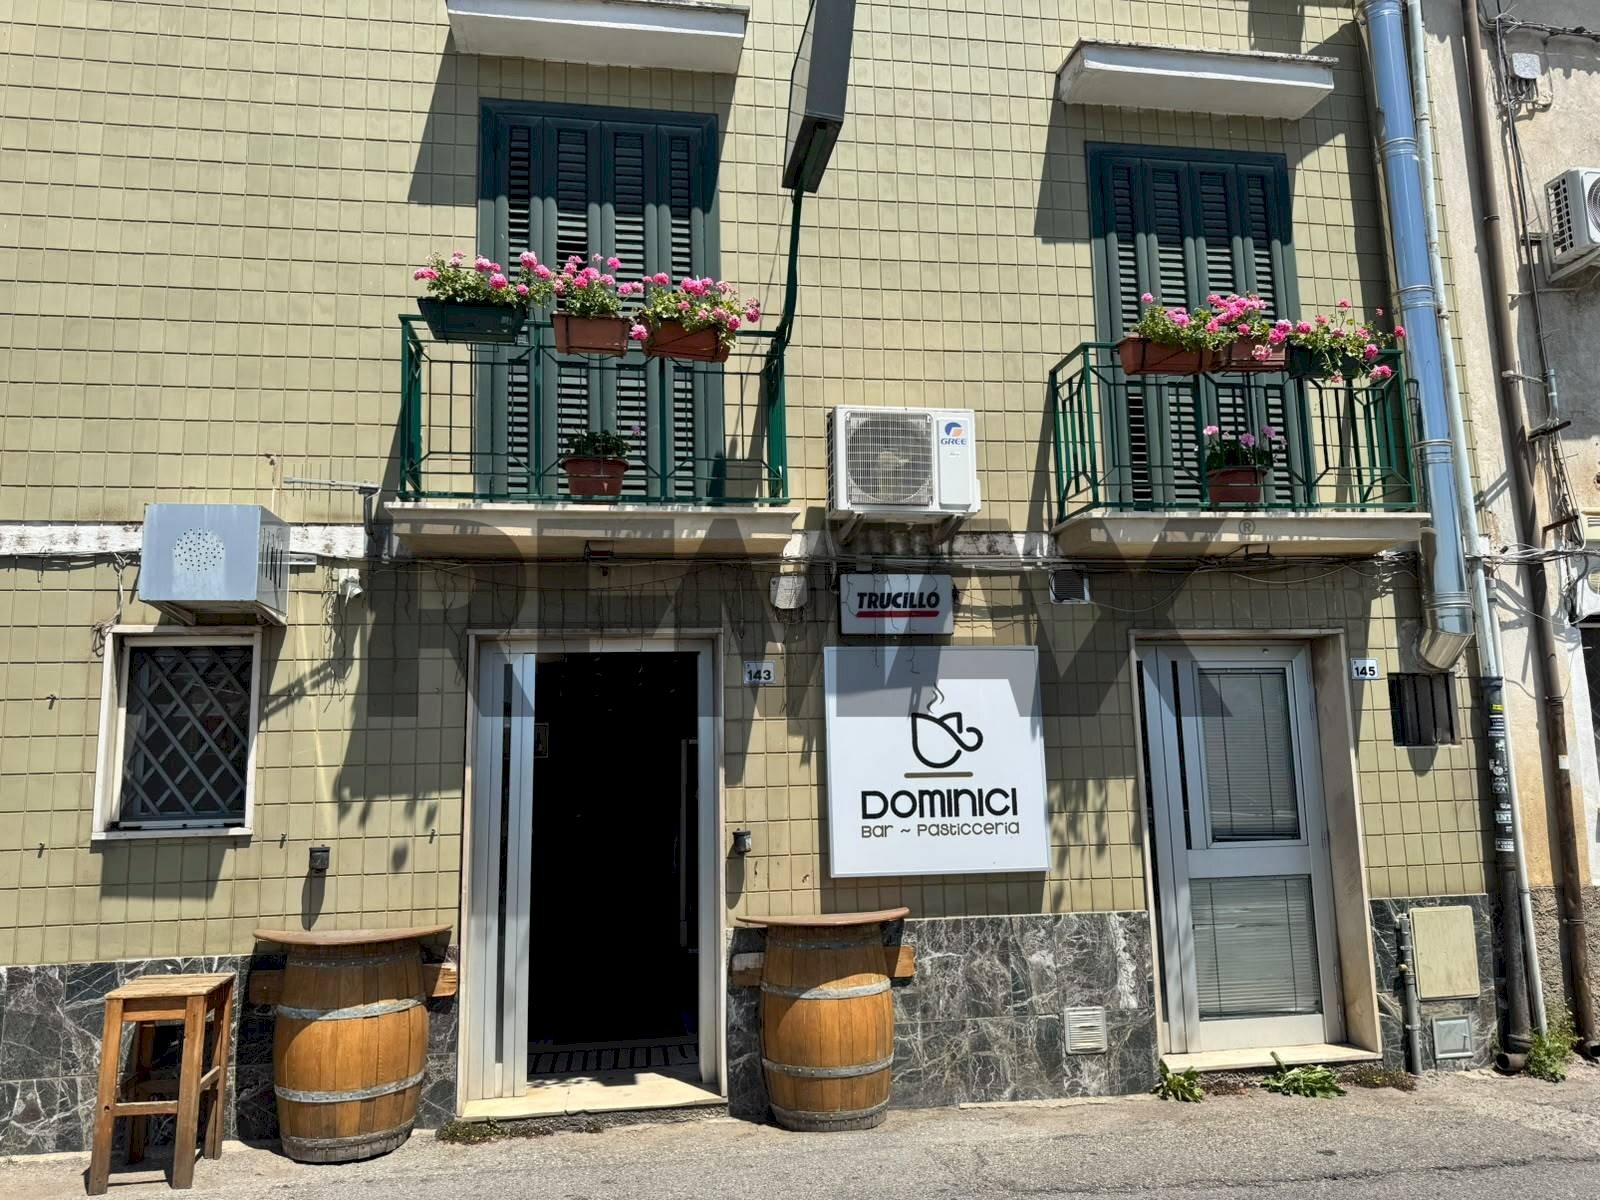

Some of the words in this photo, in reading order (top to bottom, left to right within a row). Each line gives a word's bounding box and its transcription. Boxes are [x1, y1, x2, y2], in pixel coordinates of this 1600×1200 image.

[940, 437, 967, 446] GREE
[857, 591, 940, 609] TRUCILLO
[747, 669, 771, 681] 143
[1354, 666, 1376, 677] 145
[861, 788, 1018, 820] DOMINICI
[917, 821, 1020, 837] Pasticceria
